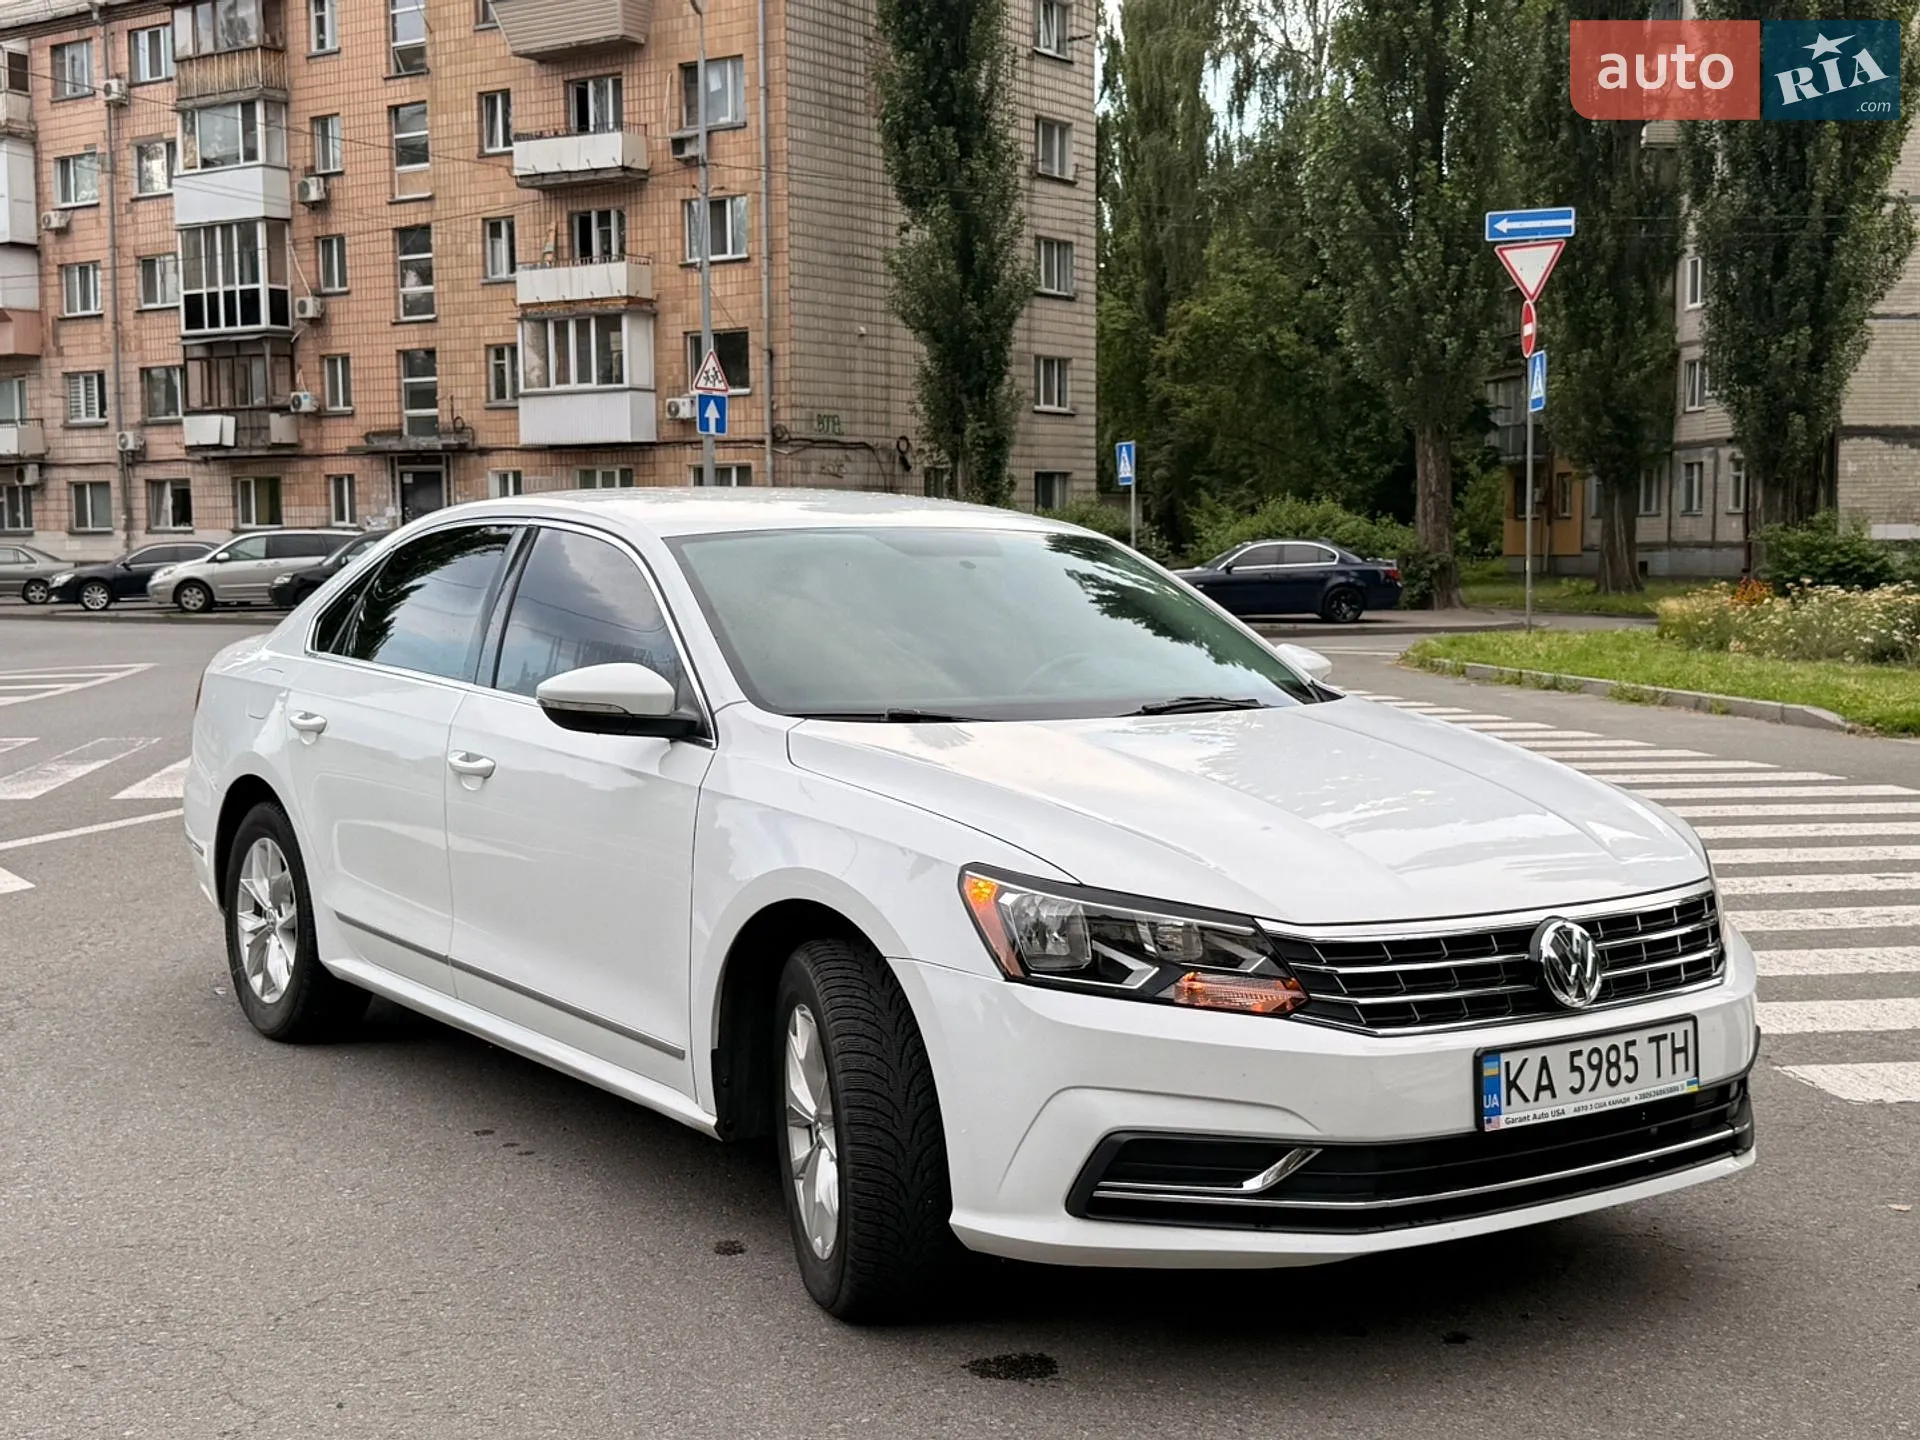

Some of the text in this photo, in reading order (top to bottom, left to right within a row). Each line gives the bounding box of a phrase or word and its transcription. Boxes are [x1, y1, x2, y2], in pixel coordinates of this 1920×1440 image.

[1504, 1029, 1690, 1106] KA 5985 TH
[1483, 1094, 1500, 1109] UA
[1504, 1108, 1566, 1125] Garant Auto USA
